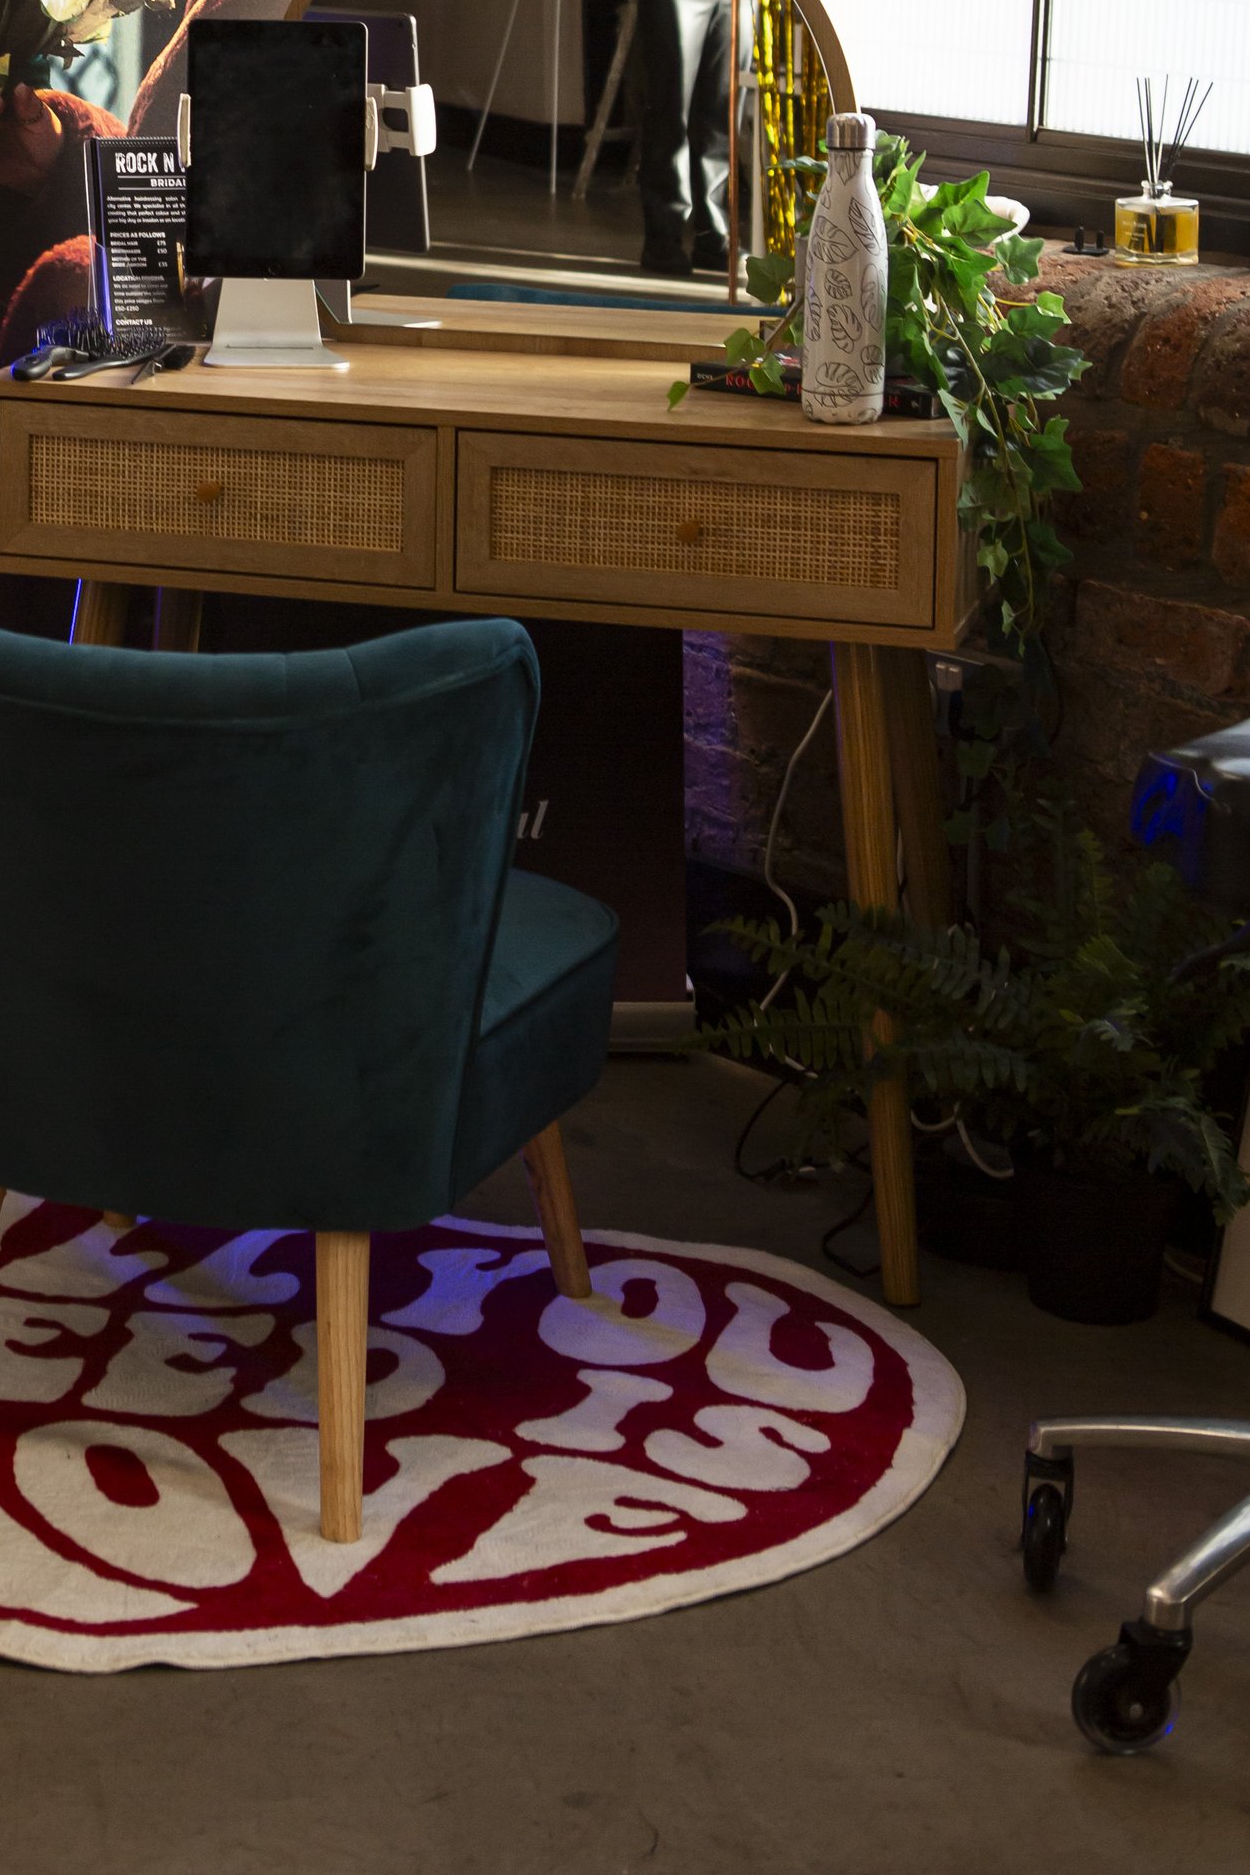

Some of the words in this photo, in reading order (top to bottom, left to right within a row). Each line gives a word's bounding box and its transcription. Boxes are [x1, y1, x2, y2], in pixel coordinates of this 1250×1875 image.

[115, 152, 158, 173] ROCK
[163, 152, 175, 173] N
[380, 1248, 874, 1414] YOU
[514, 1369, 831, 1492] IS
